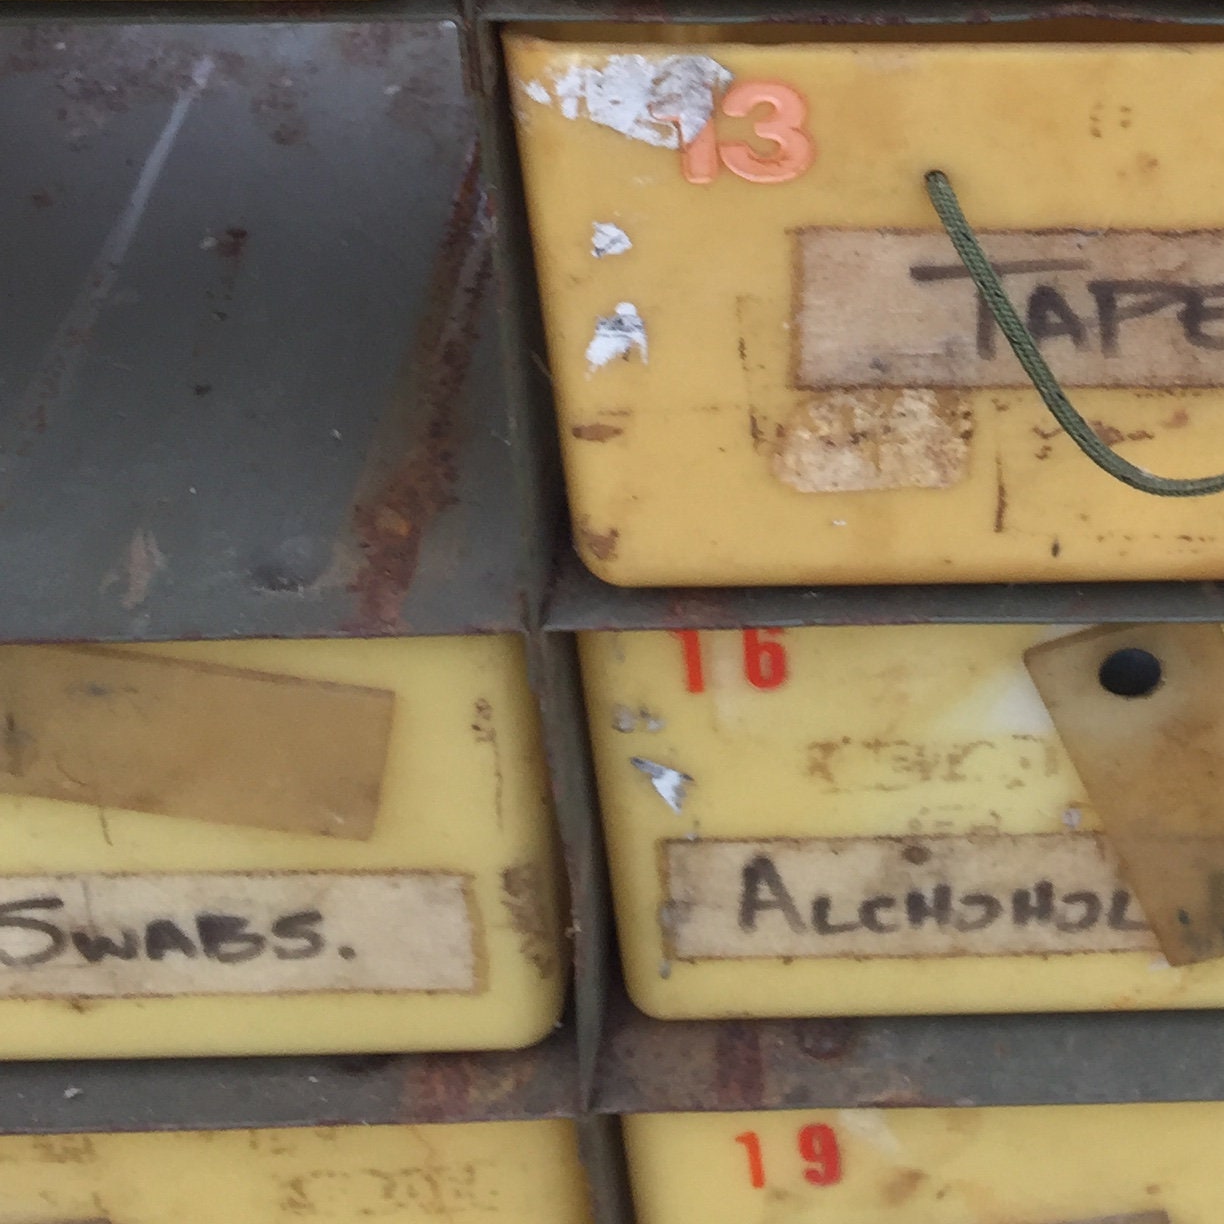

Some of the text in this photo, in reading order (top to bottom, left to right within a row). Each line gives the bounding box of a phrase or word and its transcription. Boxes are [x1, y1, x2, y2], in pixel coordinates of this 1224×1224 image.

[646, 78, 817, 186] 13
[668, 628, 789, 694] 16
[0, 896, 357, 965] SWABS.
[735, 1122, 842, 1189] 19
